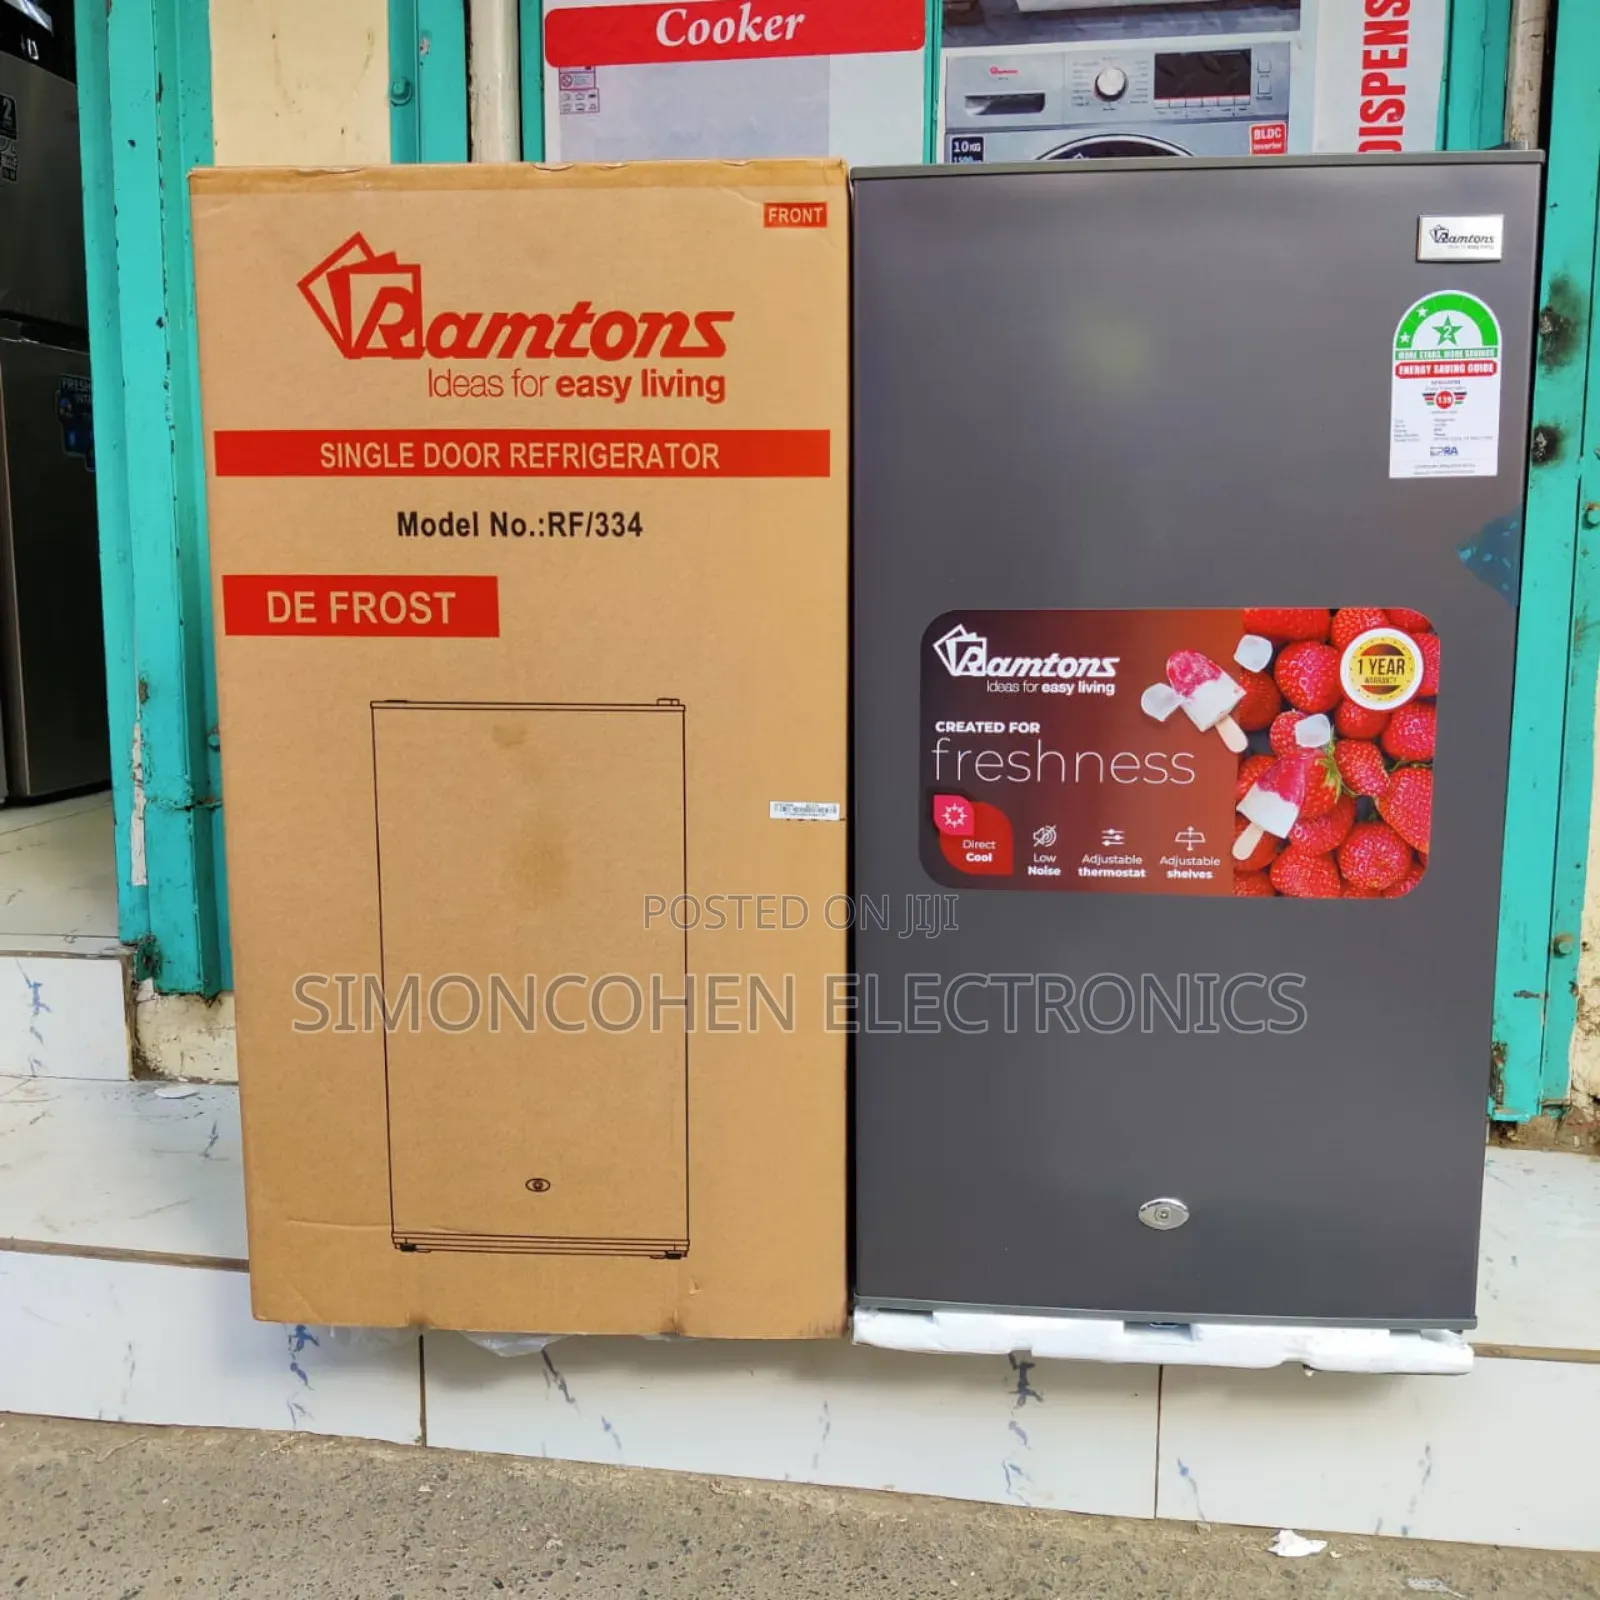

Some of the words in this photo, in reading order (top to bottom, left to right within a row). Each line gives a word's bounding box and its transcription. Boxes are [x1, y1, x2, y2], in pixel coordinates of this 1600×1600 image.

[656, 3, 807, 47] Cooker
[1254, 127, 1282, 140] BLDC
[768, 206, 823, 224] FRONT
[340, 264, 735, 361] Ramtons
[1443, 325, 1452, 339] 2
[429, 369, 504, 398] Ideas
[512, 369, 551, 398] for
[556, 373, 633, 404] easy
[641, 369, 726, 404] living
[320, 442, 414, 470] SINGLE
[424, 442, 501, 470] DOOR
[510, 442, 720, 470] REFRIGERATOR
[398, 511, 480, 538] Model
[490, 511, 643, 538] No.:RF/334
[267, 591, 316, 624] DE
[330, 592, 456, 624] FROST
[950, 638, 1120, 677] Ramtons
[1357, 658, 1364, 675] 1
[1369, 658, 1405, 675] YEAR
[986, 680, 1020, 693] Ideas
[1022, 680, 1041, 693] for
[1041, 682, 1075, 696] easy
[1078, 680, 1116, 696] living
[935, 720, 1005, 733] CREATED
[1009, 721, 1041, 734] FOR
[932, 738, 1196, 785] freshness
[962, 839, 996, 850] Direct
[966, 852, 993, 863] Cool
[1034, 853, 1057, 864] Low
[1081, 854, 1143, 866] Adjustable
[1160, 855, 1221, 868] Adjustable
[1028, 865, 1062, 877] Noise
[1078, 866, 1147, 878] thermostat
[1167, 868, 1213, 879] shelves
